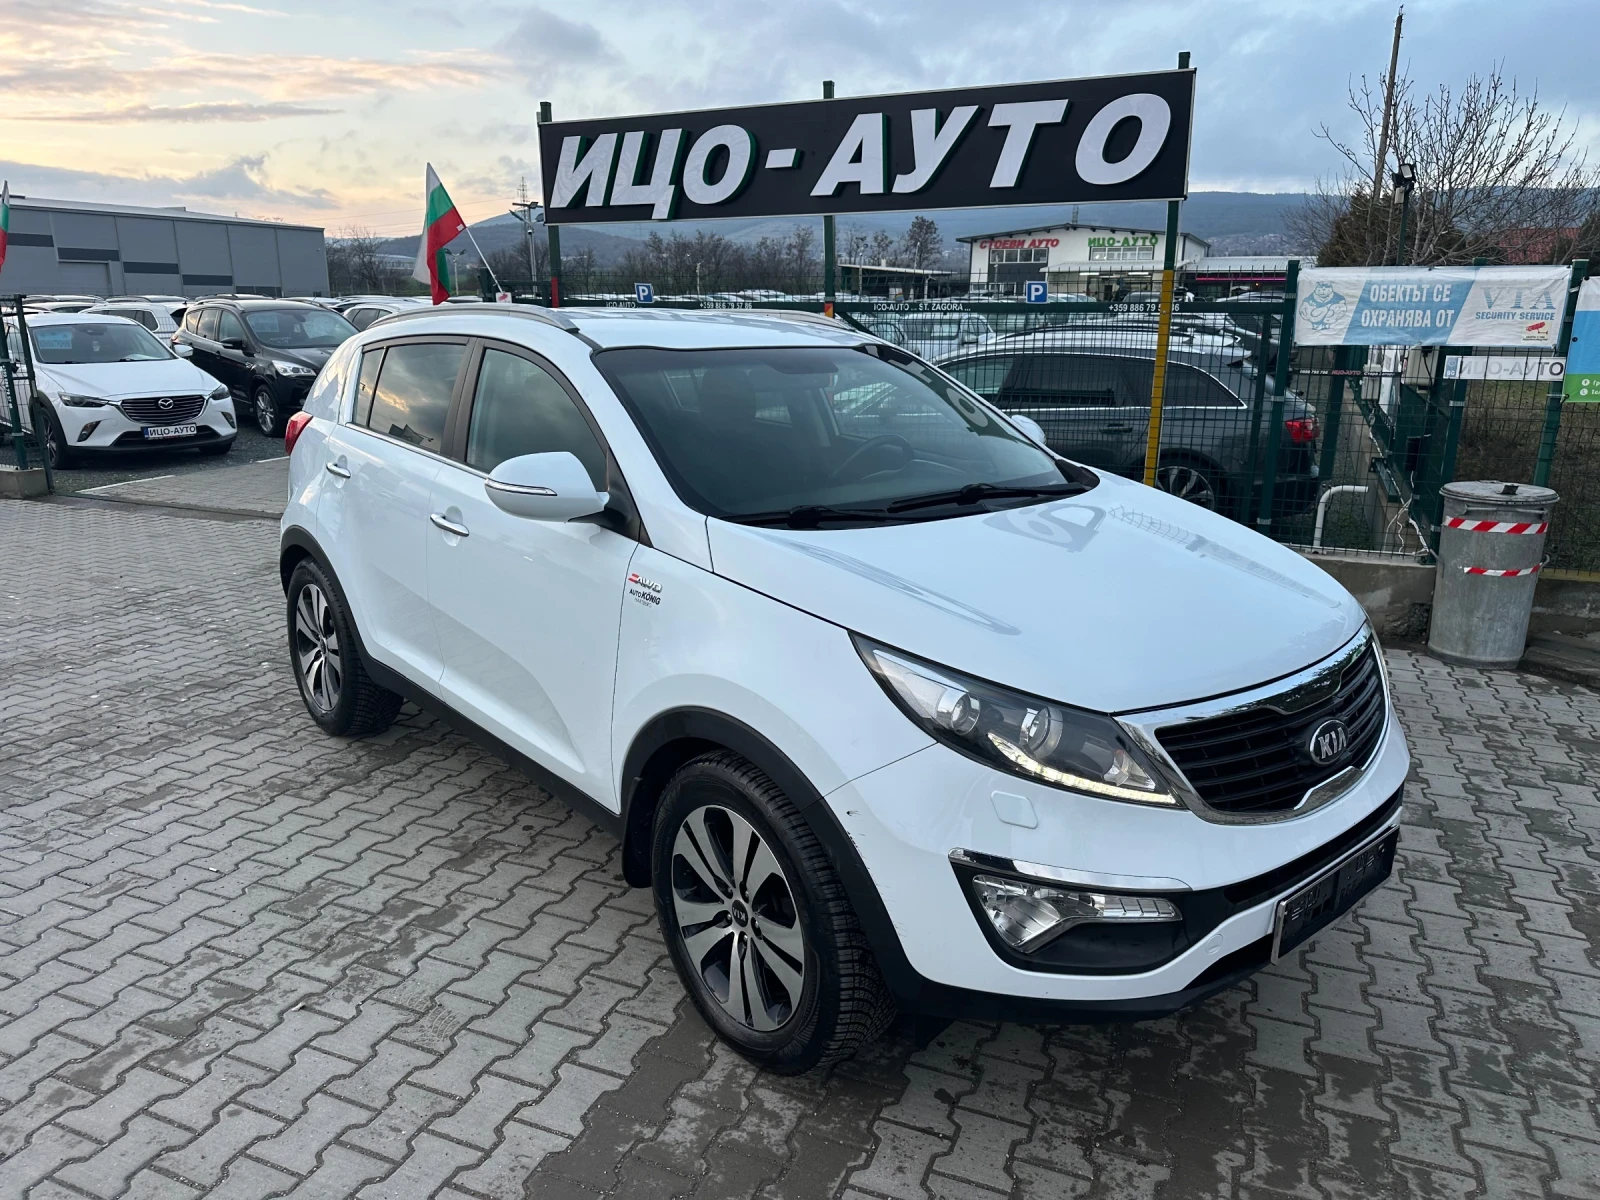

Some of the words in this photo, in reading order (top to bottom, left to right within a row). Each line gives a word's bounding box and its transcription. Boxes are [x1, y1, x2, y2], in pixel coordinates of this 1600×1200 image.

[550, 93, 1172, 220] ИЦО-АУТО
[979, 238, 1024, 249] СТОЕВИ
[1028, 238, 1060, 248] АУТО
[1087, 236, 1159, 247] ИЦО-АУТО
[1030, 284, 1044, 301] P
[1370, 284, 1427, 302] ОБЕКТЪТ
[1434, 284, 1452, 302] СЕ
[1480, 286, 1557, 310] VTA
[918, 303, 930, 311] ST.
[931, 303, 963, 311] ZAGORA
[1108, 303, 1128, 312] +359
[1129, 303, 1144, 312] 886
[1146, 303, 1156, 312] 79
[1361, 309, 1431, 328] ОХРАНЯВА
[1435, 309, 1455, 328] ОТ
[1475, 311, 1516, 320] SECURITY
[1519, 311, 1555, 321] SERVICE
[1459, 361, 1564, 376] ИЦО-АУТО
[149, 426, 196, 436] ИЦО-АУТО
